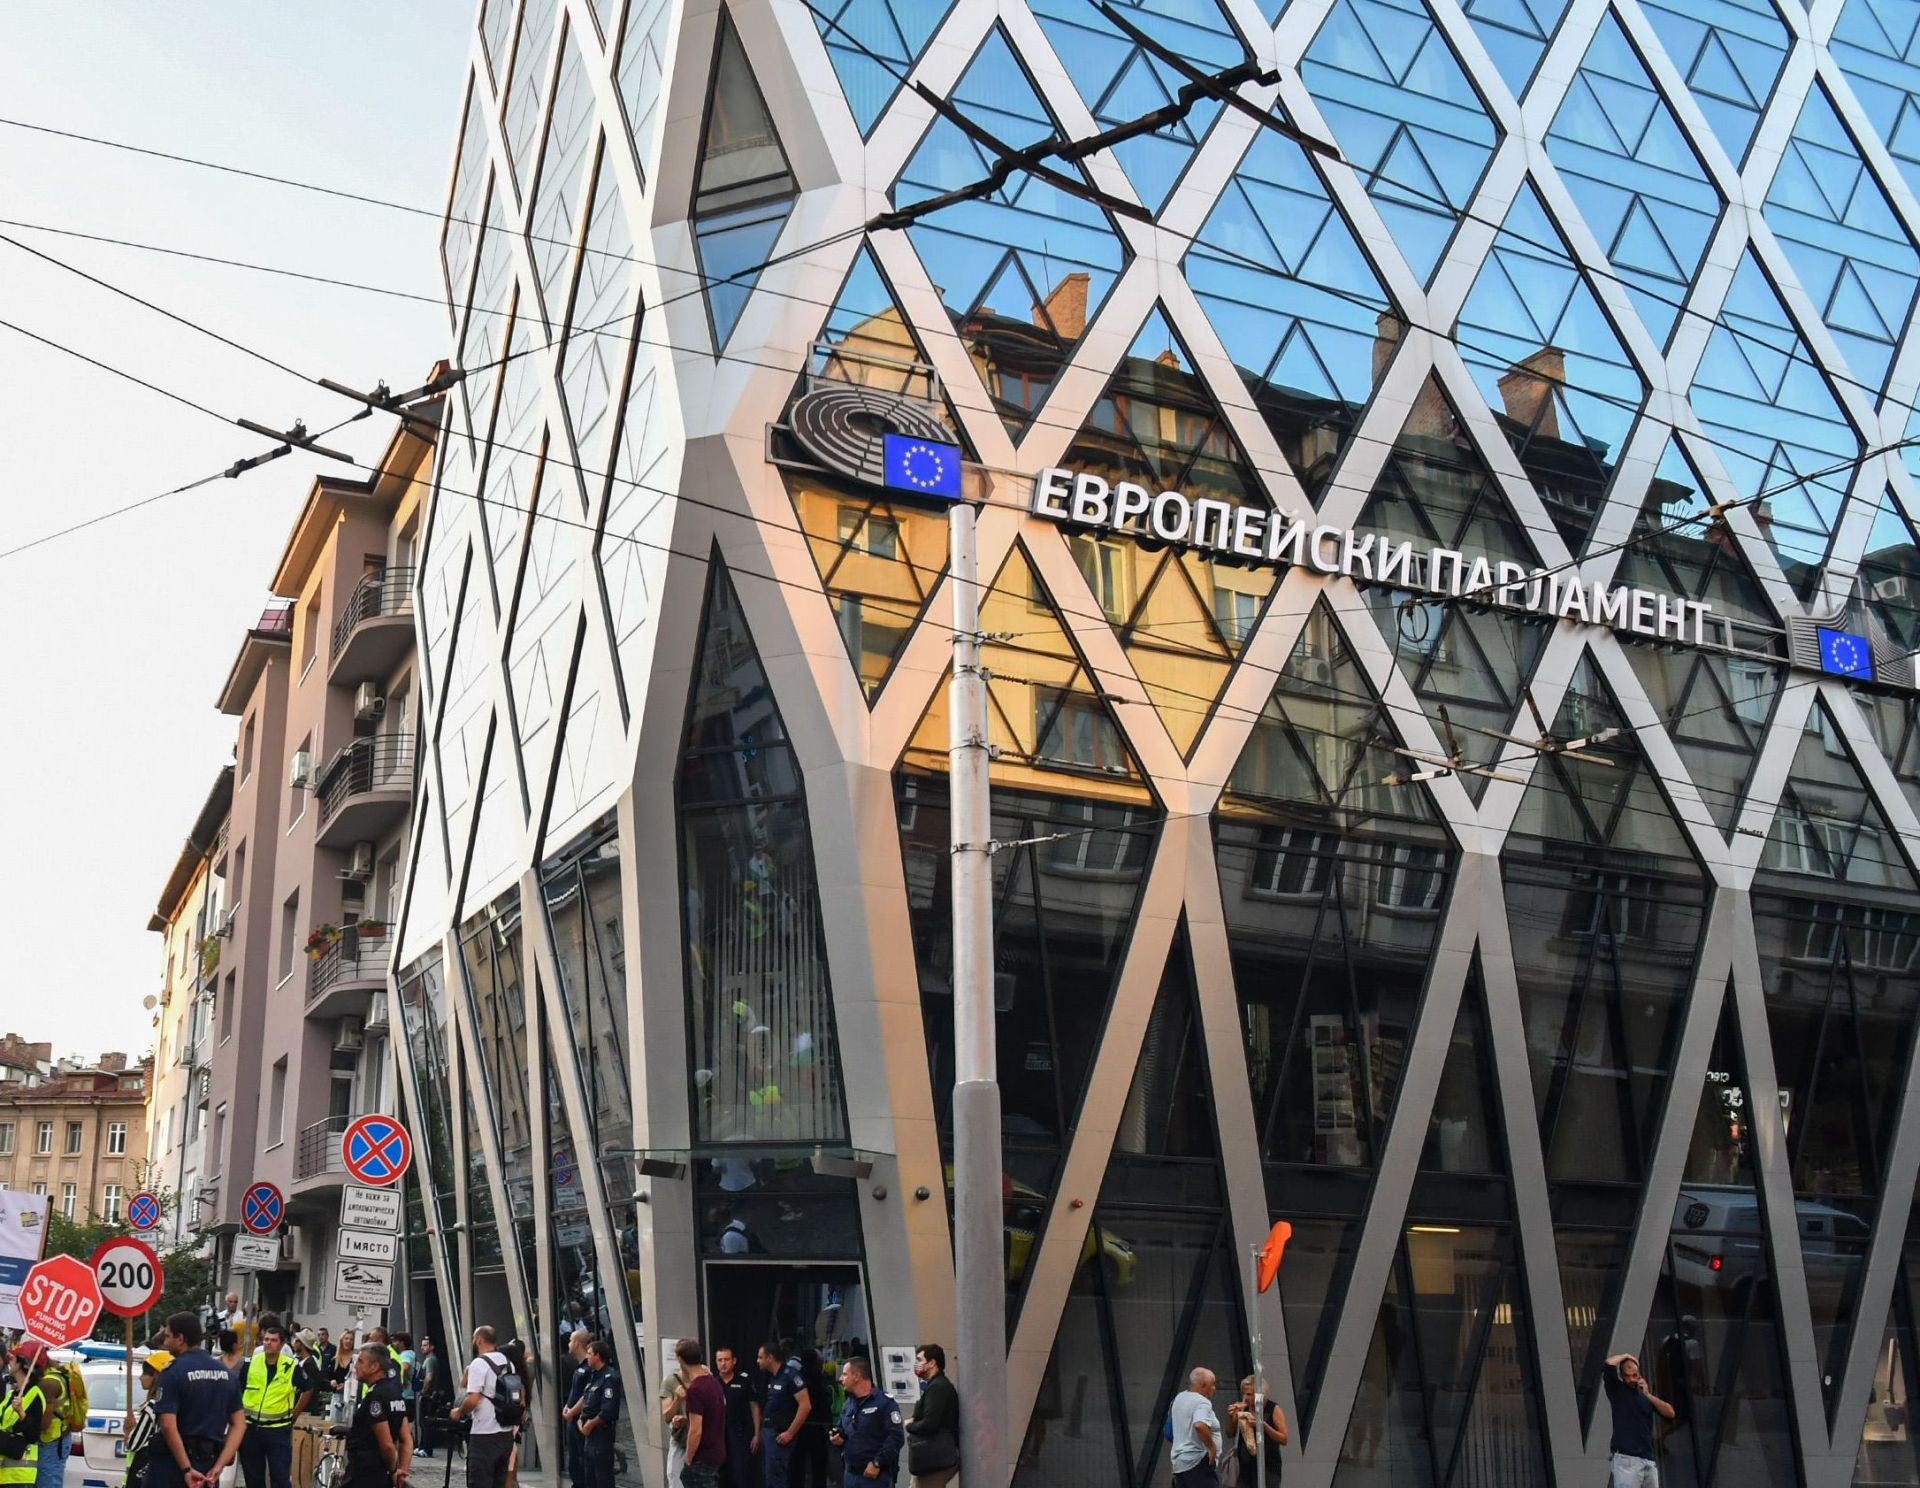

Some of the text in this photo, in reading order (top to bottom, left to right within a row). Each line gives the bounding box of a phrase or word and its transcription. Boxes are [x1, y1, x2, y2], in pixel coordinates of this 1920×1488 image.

[1034, 466, 1712, 645] ЕВРОПЕЙСКИ ПАРЛАМЕНТ
[346, 1237, 350, 1250] 1
[101, 1261, 153, 1290] 200
[26, 1274, 94, 1327] STOP
[28, 1318, 66, 1342] OUR MAFIA
[35, 1310, 66, 1331] FUNDING
[187, 1369, 229, 1381] ПОЛИЦИЯ
